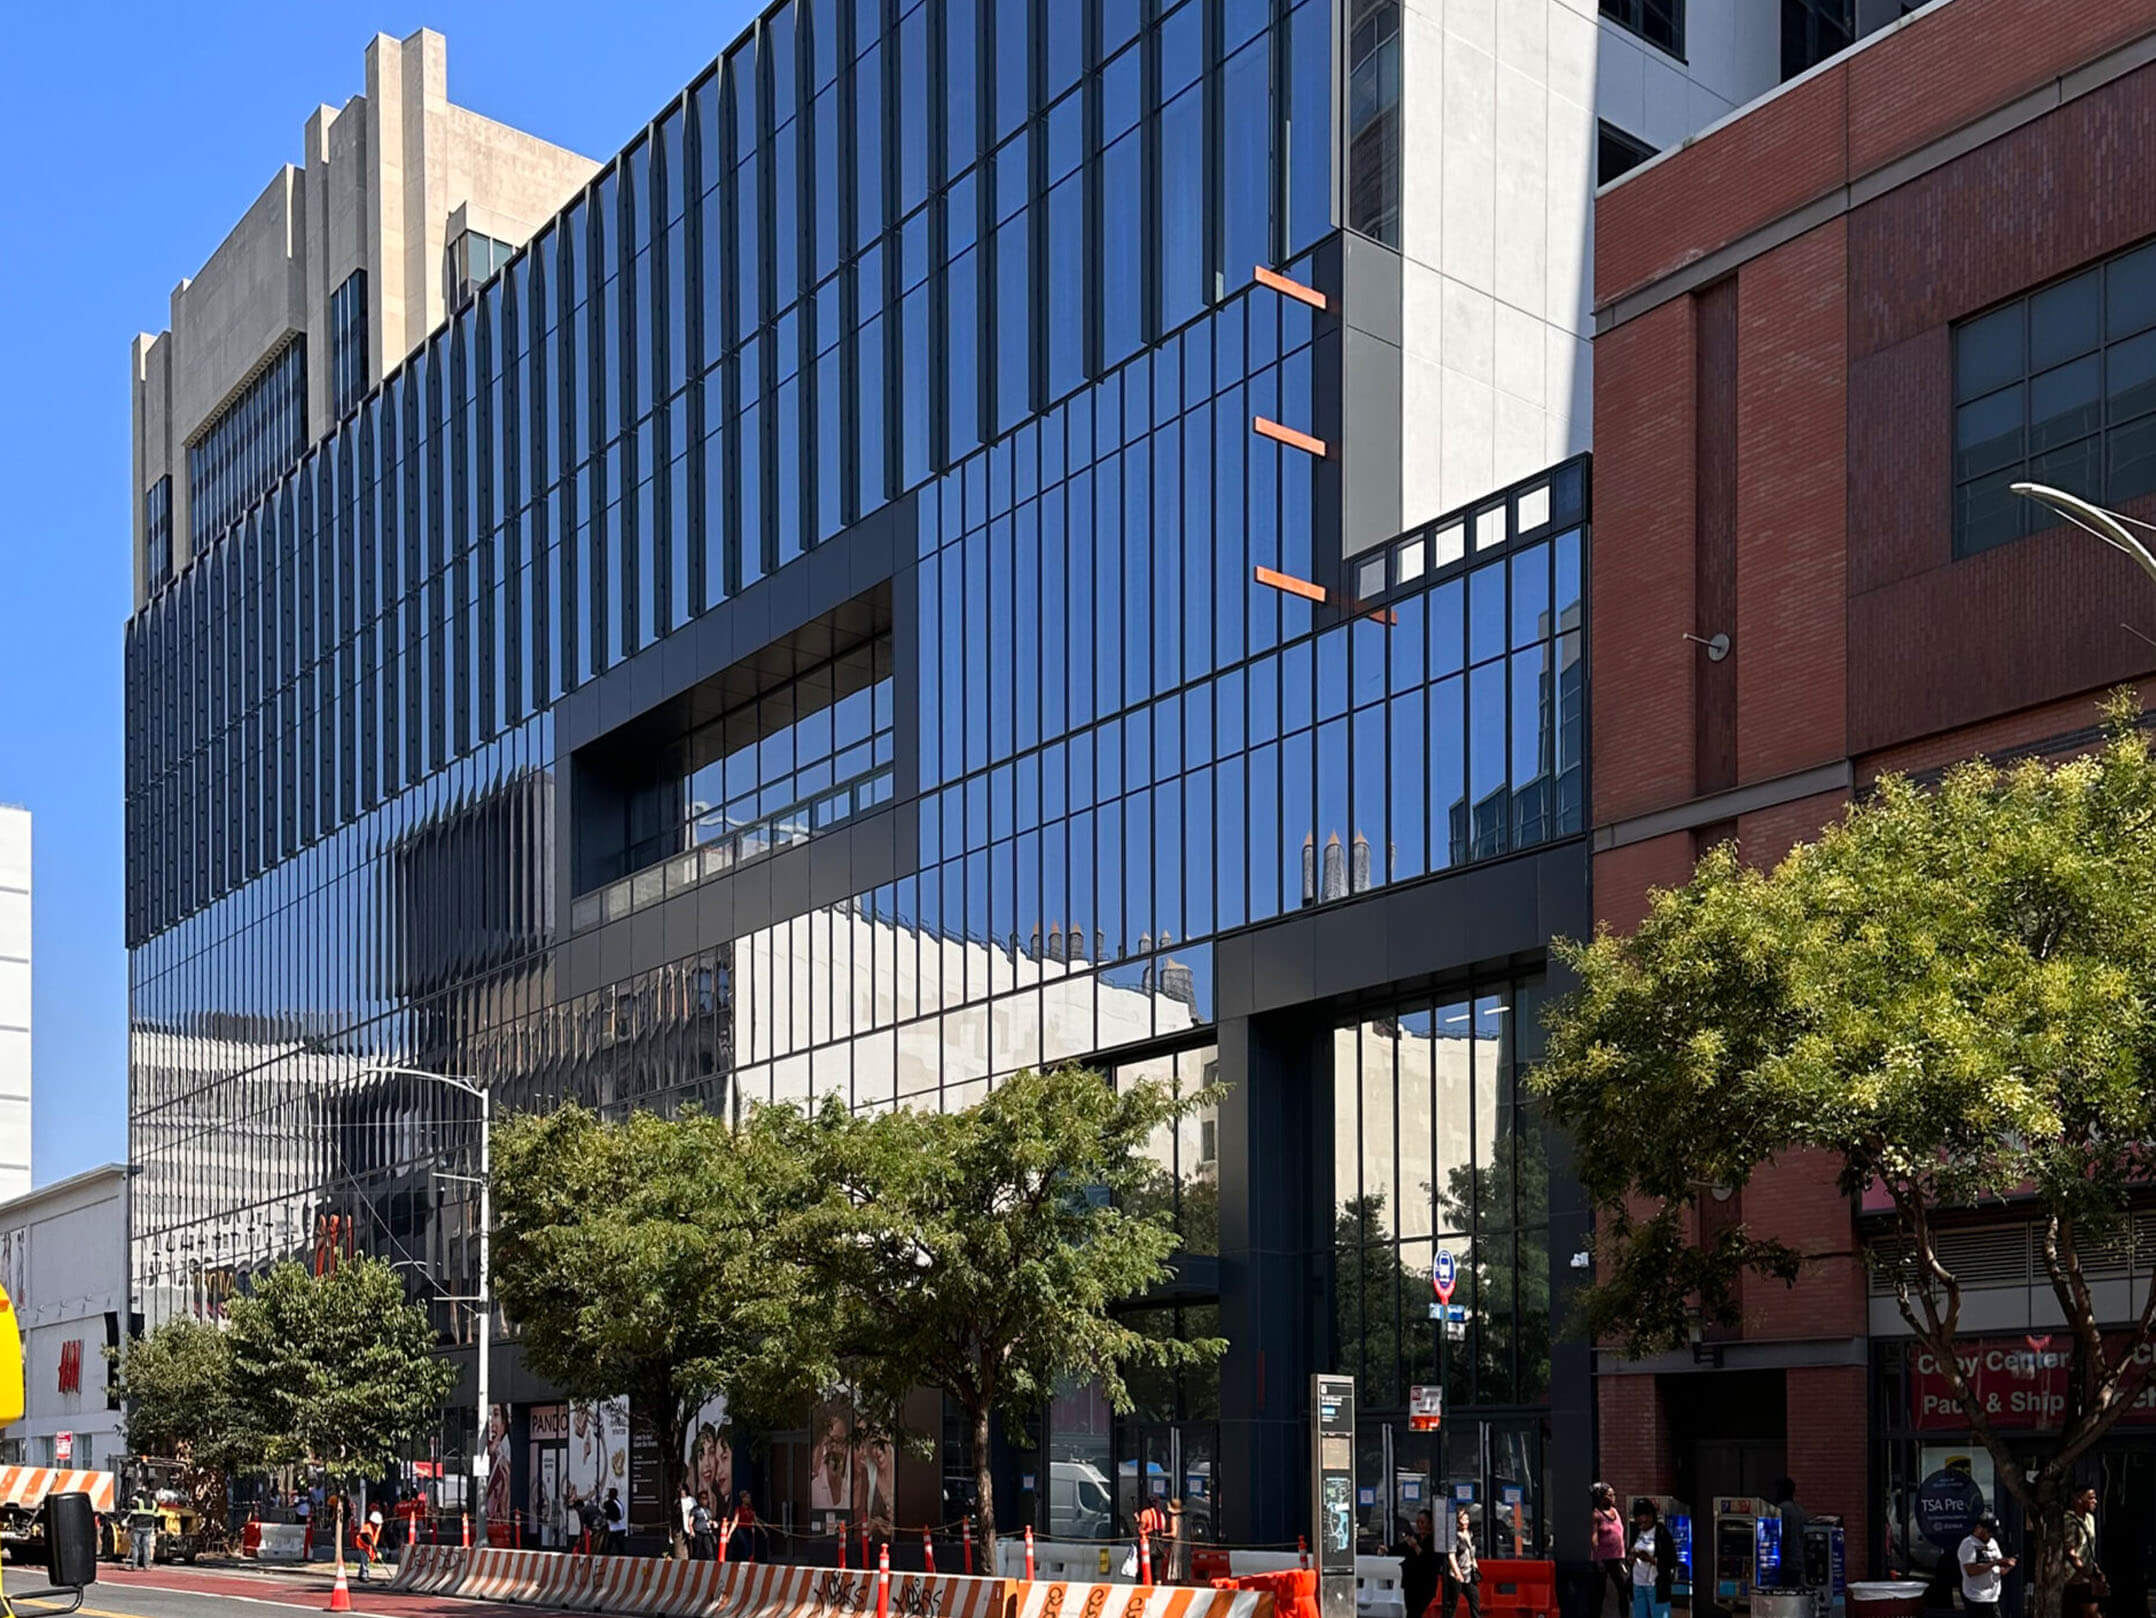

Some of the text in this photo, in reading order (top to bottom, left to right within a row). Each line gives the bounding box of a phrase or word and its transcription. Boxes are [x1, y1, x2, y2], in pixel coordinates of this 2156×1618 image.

[1918, 1350, 2071, 1377] Cy Center
[1923, 1390, 2066, 1416] Pac & Ship
[1921, 1498, 1943, 1513] TSA
